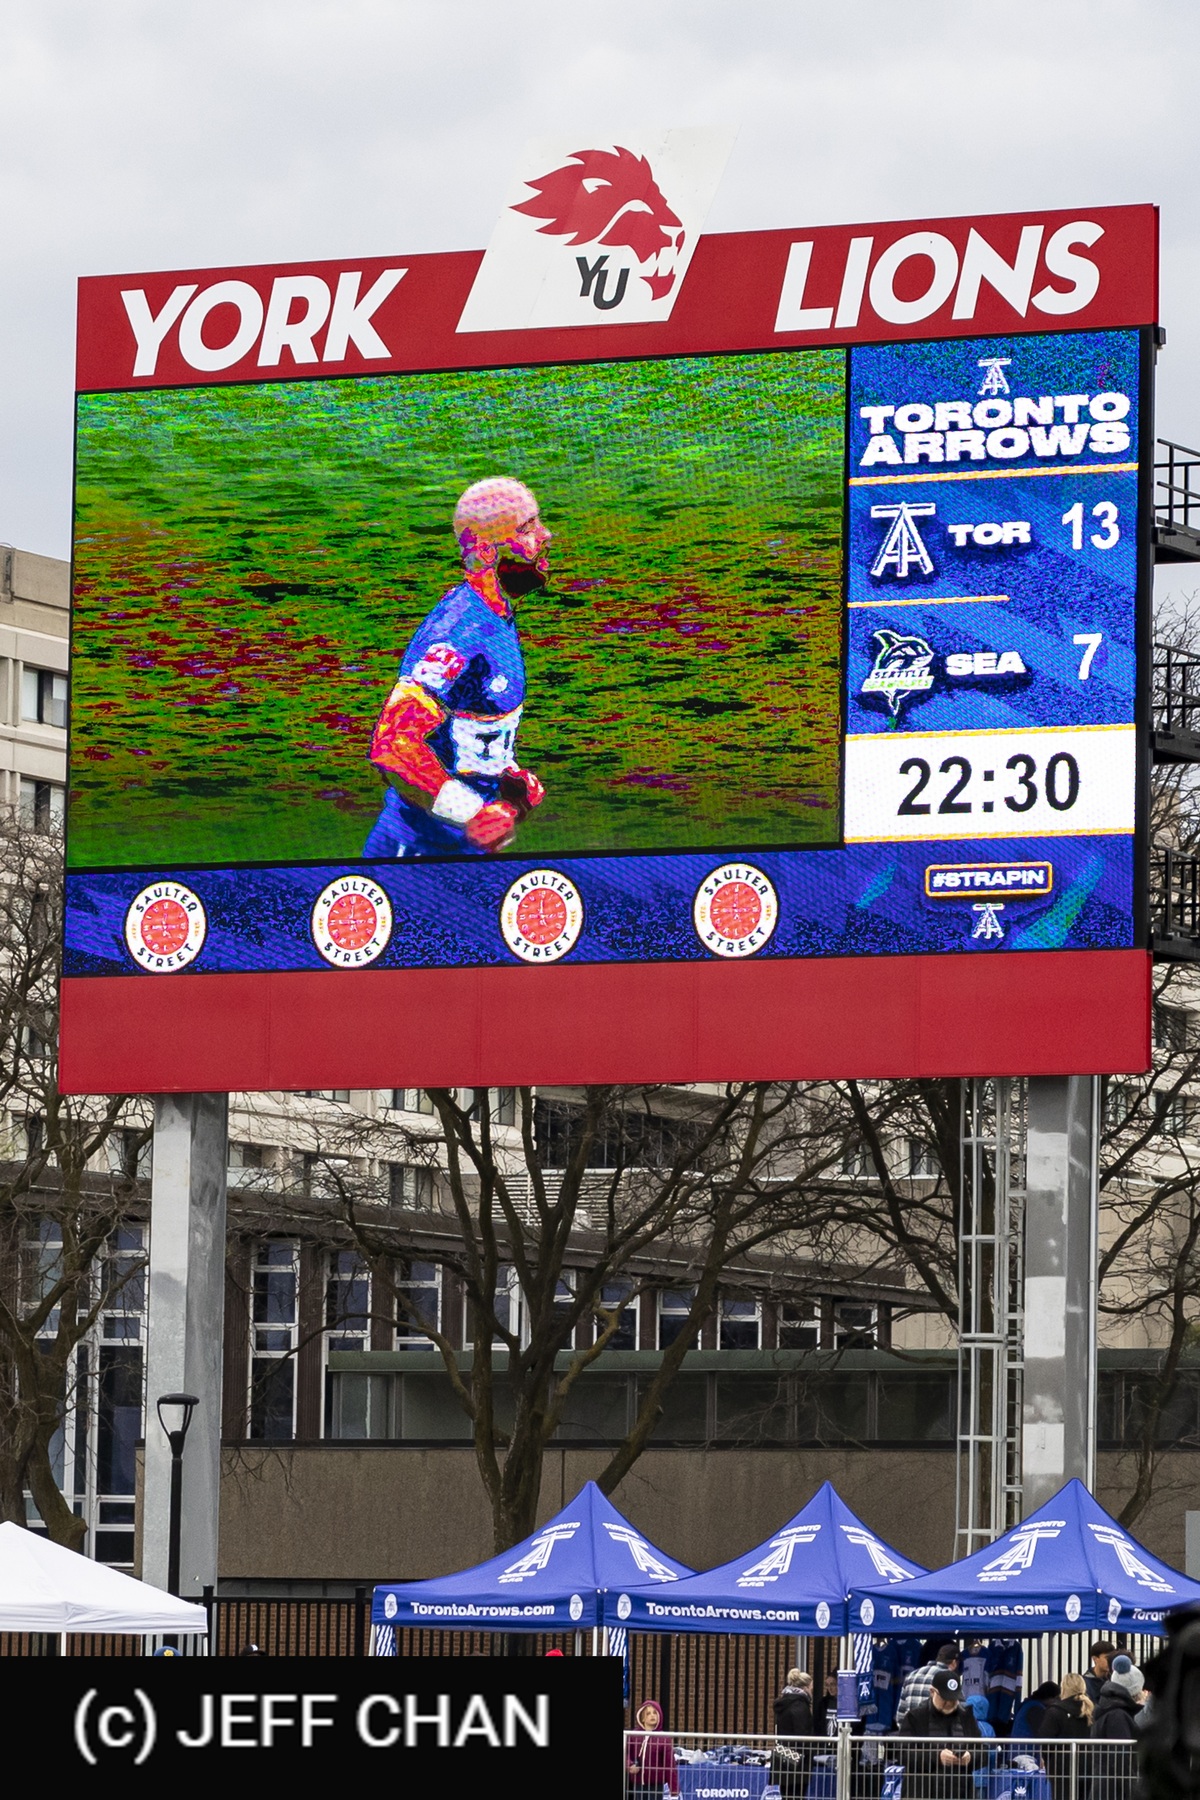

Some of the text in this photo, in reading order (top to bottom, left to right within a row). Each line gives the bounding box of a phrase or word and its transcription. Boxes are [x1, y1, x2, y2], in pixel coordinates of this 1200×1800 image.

[575, 254, 631, 311] YU
[119, 220, 1106, 378] YORK LIONS
[859, 391, 1131, 436] TORONTO
[859, 421, 1131, 468] ARROWS
[947, 501, 1121, 551] TOR 13
[946, 632, 1103, 681] SEA 7
[896, 751, 1081, 816] 22:30
[511, 875, 574, 901] SAULTER
[704, 868, 769, 896] SAULTER
[932, 869, 1045, 888] #STRAPIN
[136, 887, 198, 913] SAULTER
[322, 881, 384, 908] SAULTER
[324, 937, 381, 963] STREET
[513, 932, 571, 957] STREET
[706, 927, 766, 952] STREET
[137, 942, 194, 967] STREET
[410, 1601, 555, 1617] TorontoArrows.com
[645, 1602, 800, 1621] TorontoArrows.com
[889, 1603, 1049, 1619] TorontoArrows.com
[695, 1788, 749, 1798] TORONTO
